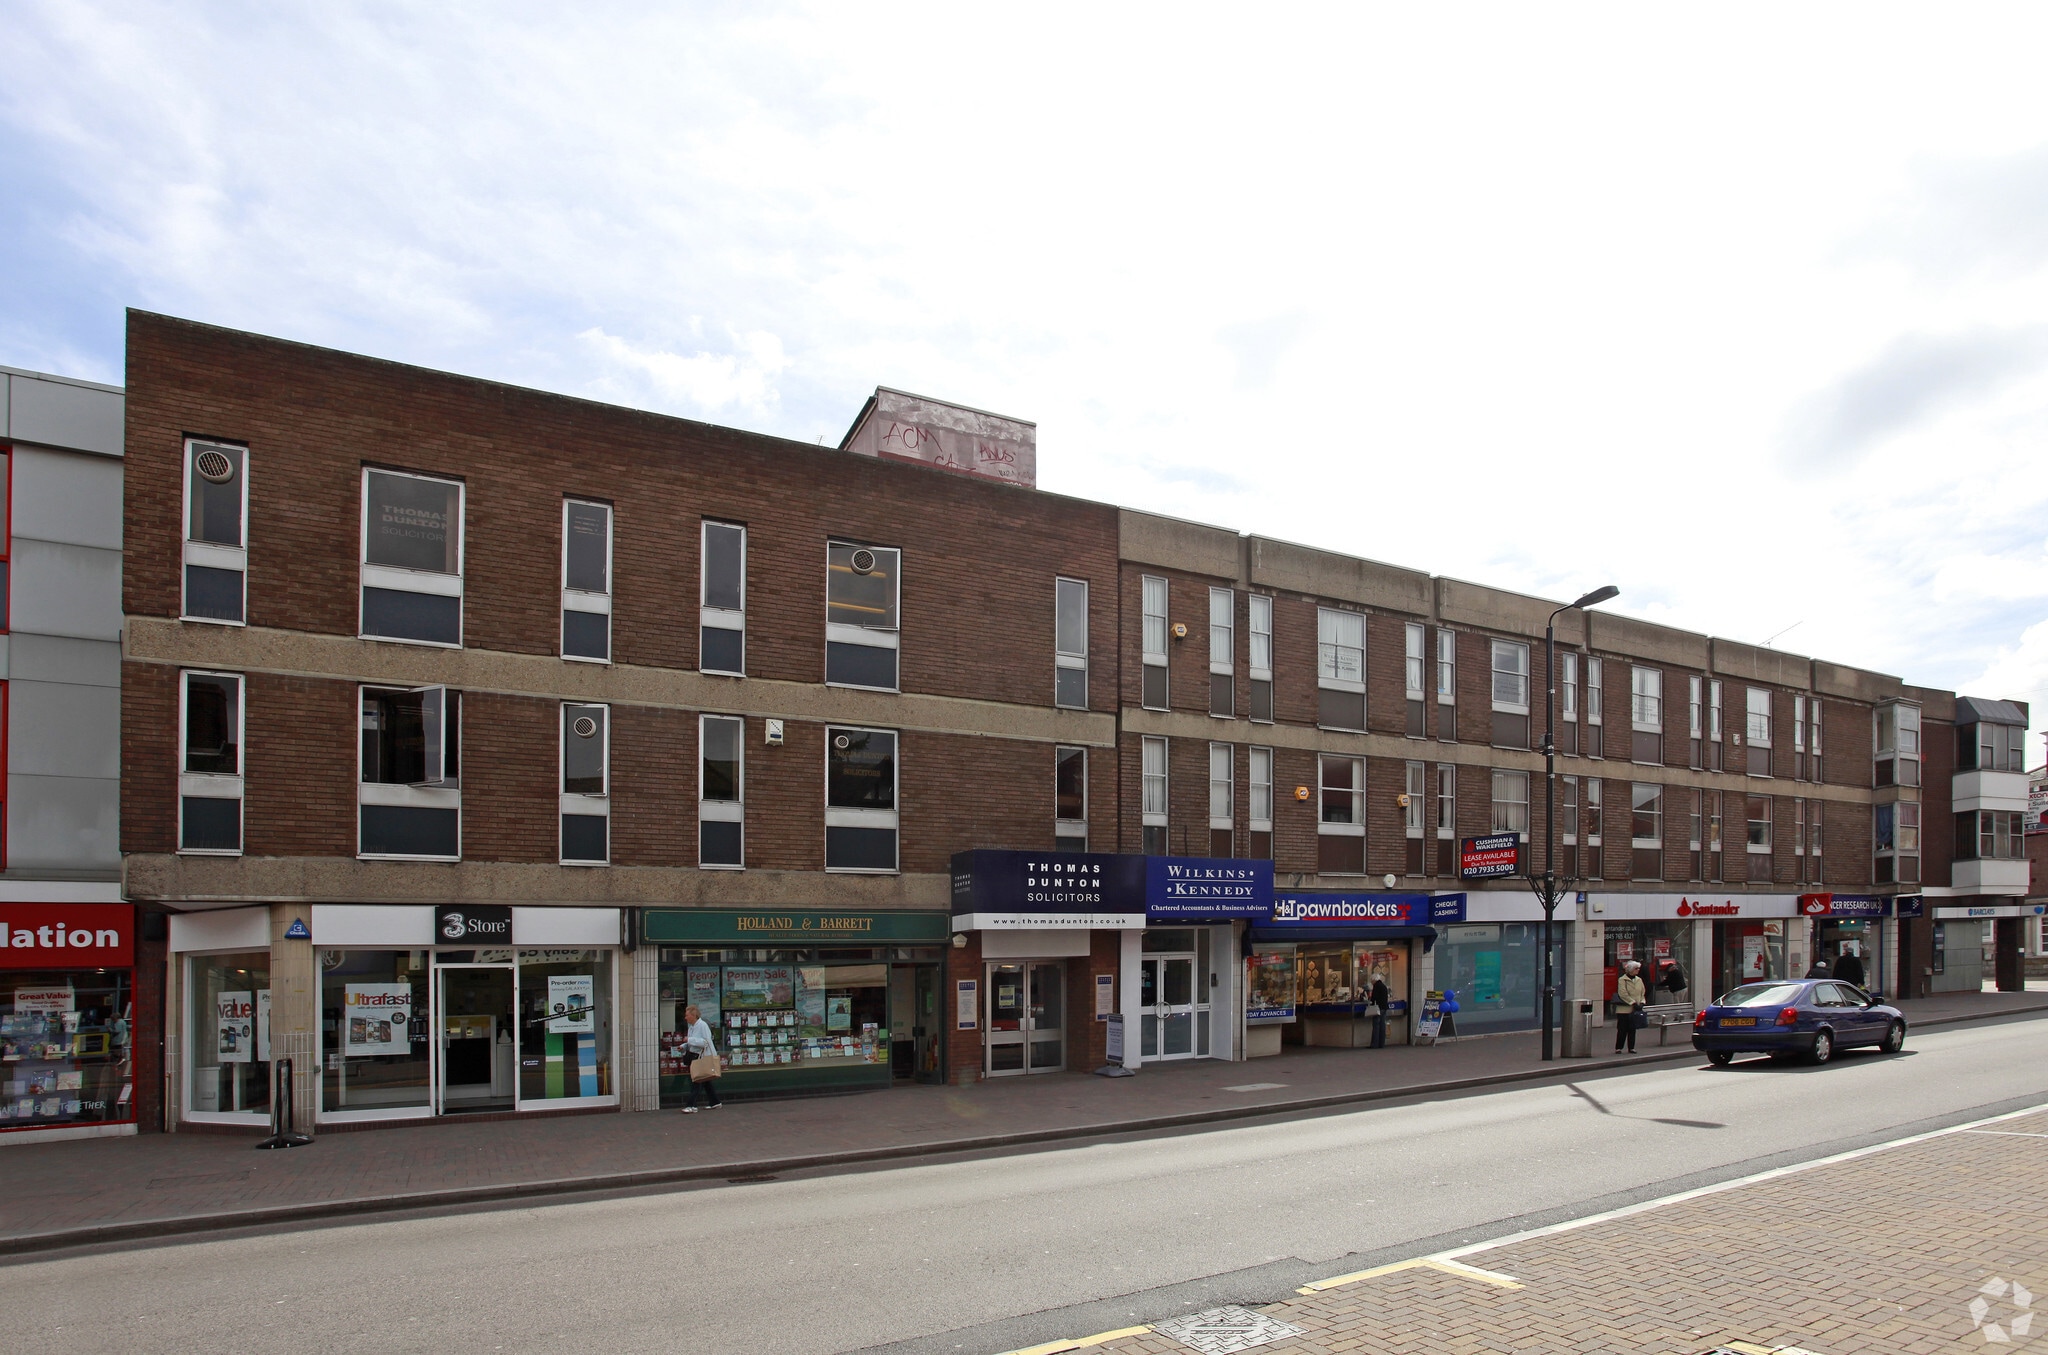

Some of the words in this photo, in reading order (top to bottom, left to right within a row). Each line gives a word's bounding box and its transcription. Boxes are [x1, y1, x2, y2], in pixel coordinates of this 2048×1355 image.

[382, 526, 448, 542] SOLICITOR
[1475, 838, 1508, 846] CUSHMAN
[1464, 854, 1482, 862] LEASE
[1482, 850, 1515, 860] AVAILABLE
[1028, 863, 1100, 873] THOMAS
[1463, 867, 1478, 875] 020
[1478, 865, 1495, 874] 7935
[1496, 863, 1514, 872] 5000
[1028, 878, 1100, 888] DUNTON
[1027, 893, 1100, 902] SOLICITORS
[1297, 900, 1398, 917] pawnbrokers
[1692, 901, 1740, 916] Santander
[1830, 900, 1843, 910] NCER
[1843, 900, 1870, 910] RESEARCH
[1870, 900, 1878, 909] UK
[1434, 909, 1458, 917] CASHING
[1973, 908, 1996, 916] BARCLAYS
[442, 912, 466, 938] 3
[737, 917, 793, 931] HOLLAND
[801, 917, 812, 931] &
[820, 917, 873, 931] BARRETT
[689, 971, 718, 981] Penny
[727, 971, 761, 981] Penny
[764, 969, 788, 979] Sale
[344, 993, 411, 1006] Ultrafast
